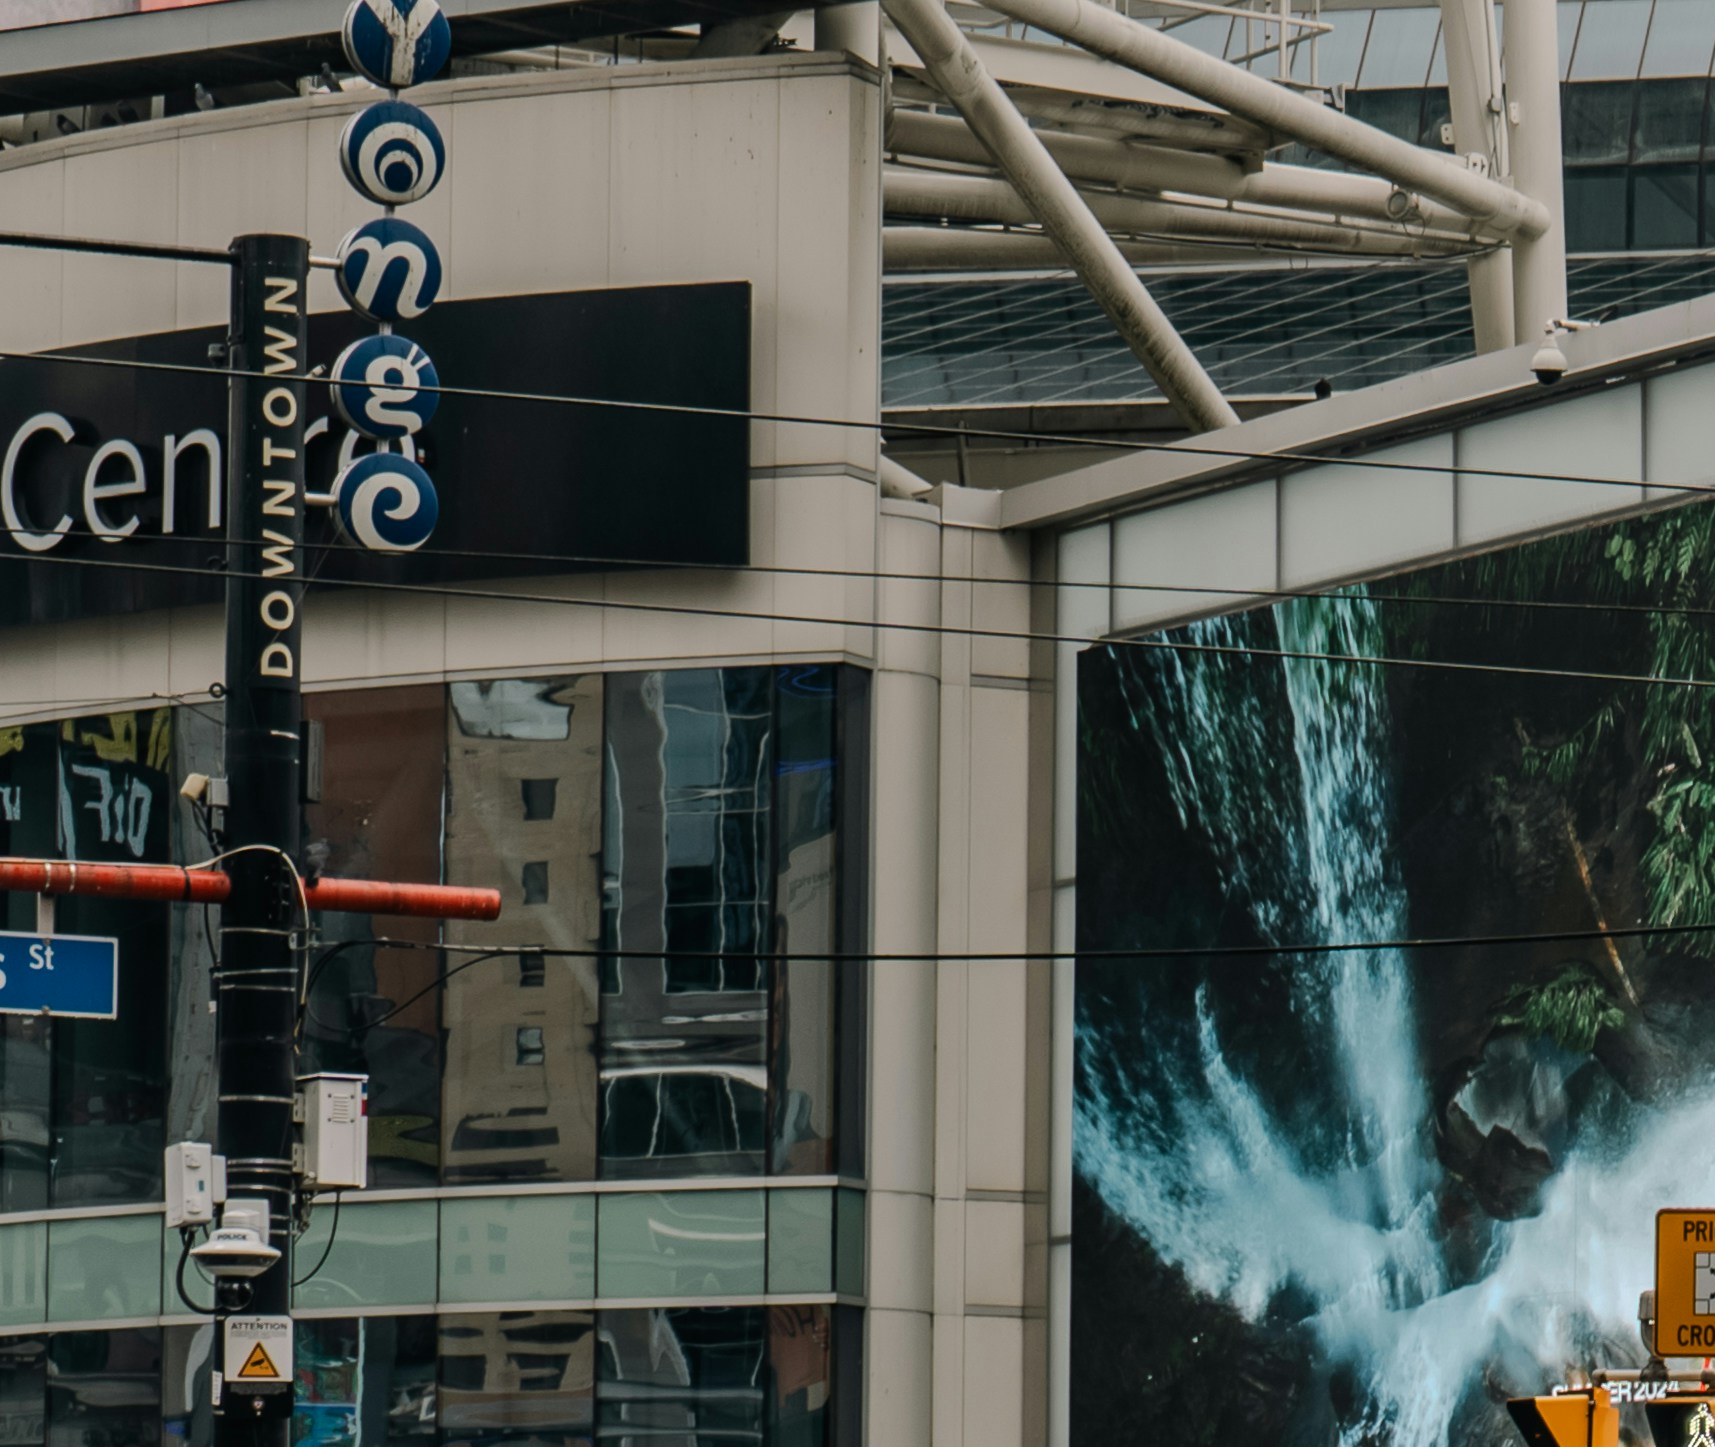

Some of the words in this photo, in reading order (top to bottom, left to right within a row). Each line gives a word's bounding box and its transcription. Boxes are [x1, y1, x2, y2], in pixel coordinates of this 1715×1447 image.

[347, 0, 440, 552] Yonge
[262, 277, 298, 678] DOWNTOWN
[29, 943, 54, 971] St
